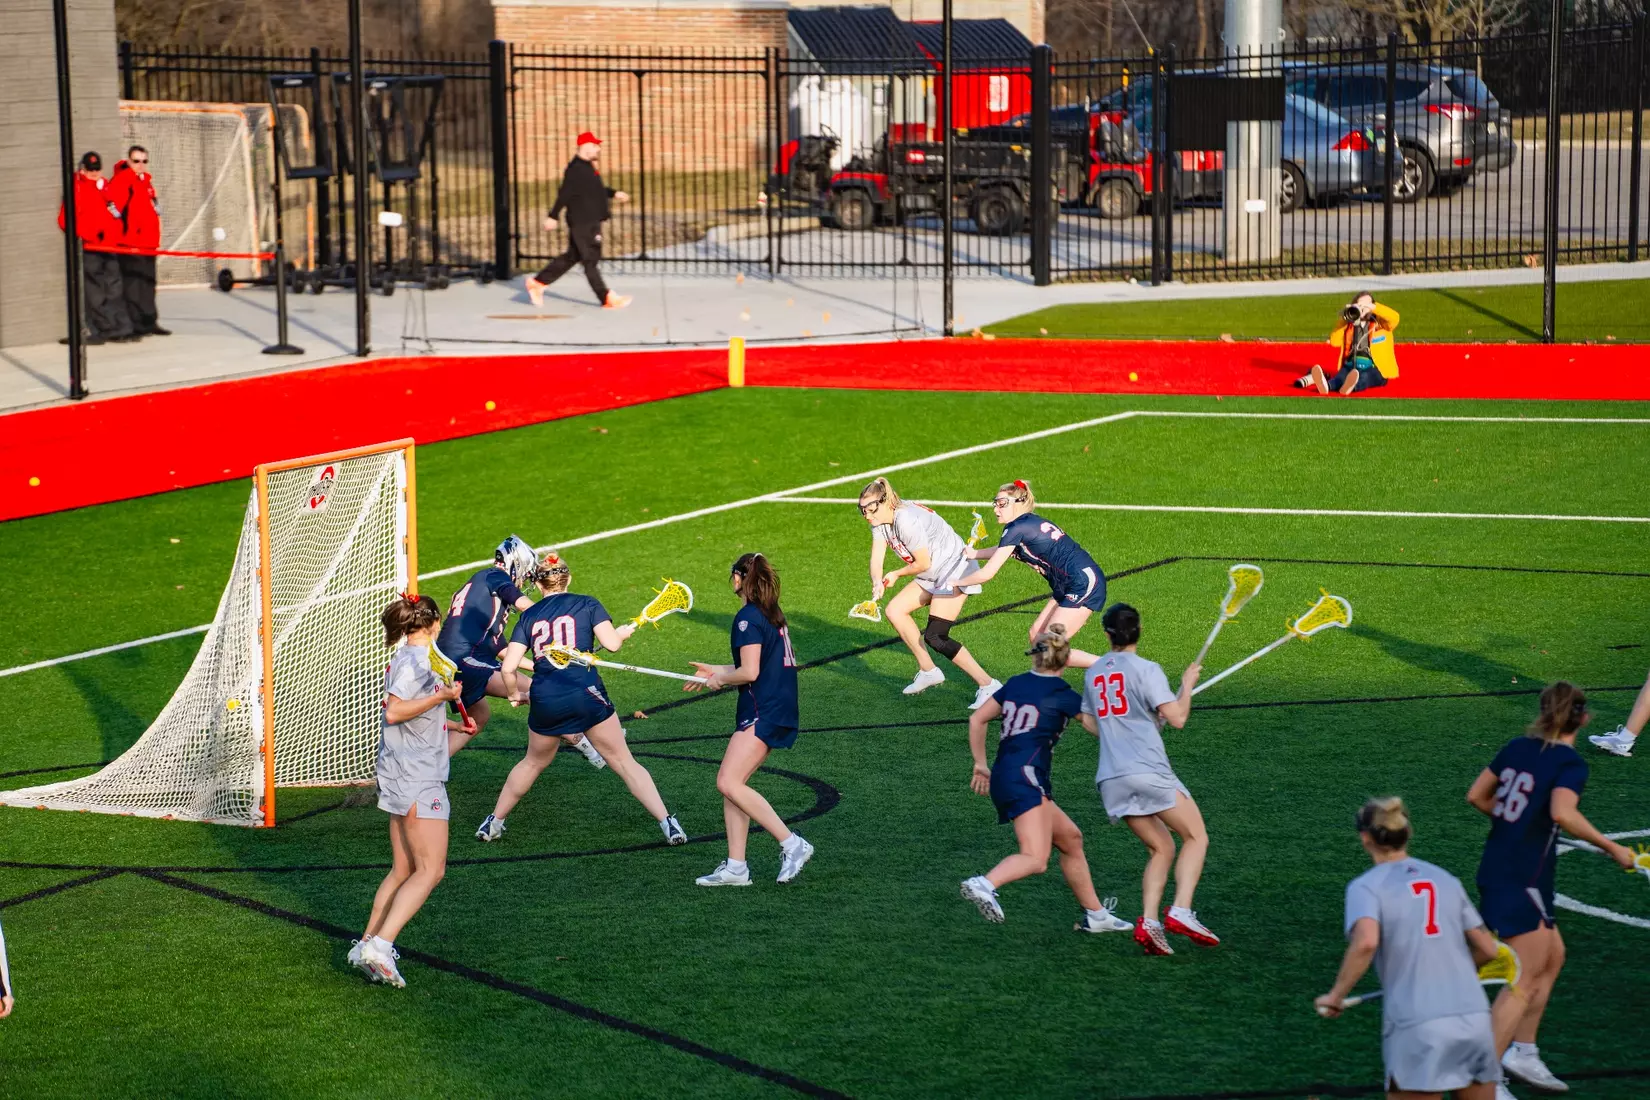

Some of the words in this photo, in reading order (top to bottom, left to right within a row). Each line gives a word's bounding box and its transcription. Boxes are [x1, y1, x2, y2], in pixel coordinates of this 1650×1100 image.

[450, 582, 472, 617] 4
[531, 615, 576, 660] 20
[1094, 672, 1129, 718] 33
[1001, 700, 1040, 739] 30
[1492, 767, 1535, 823] 26
[1410, 880, 1441, 936] 7
